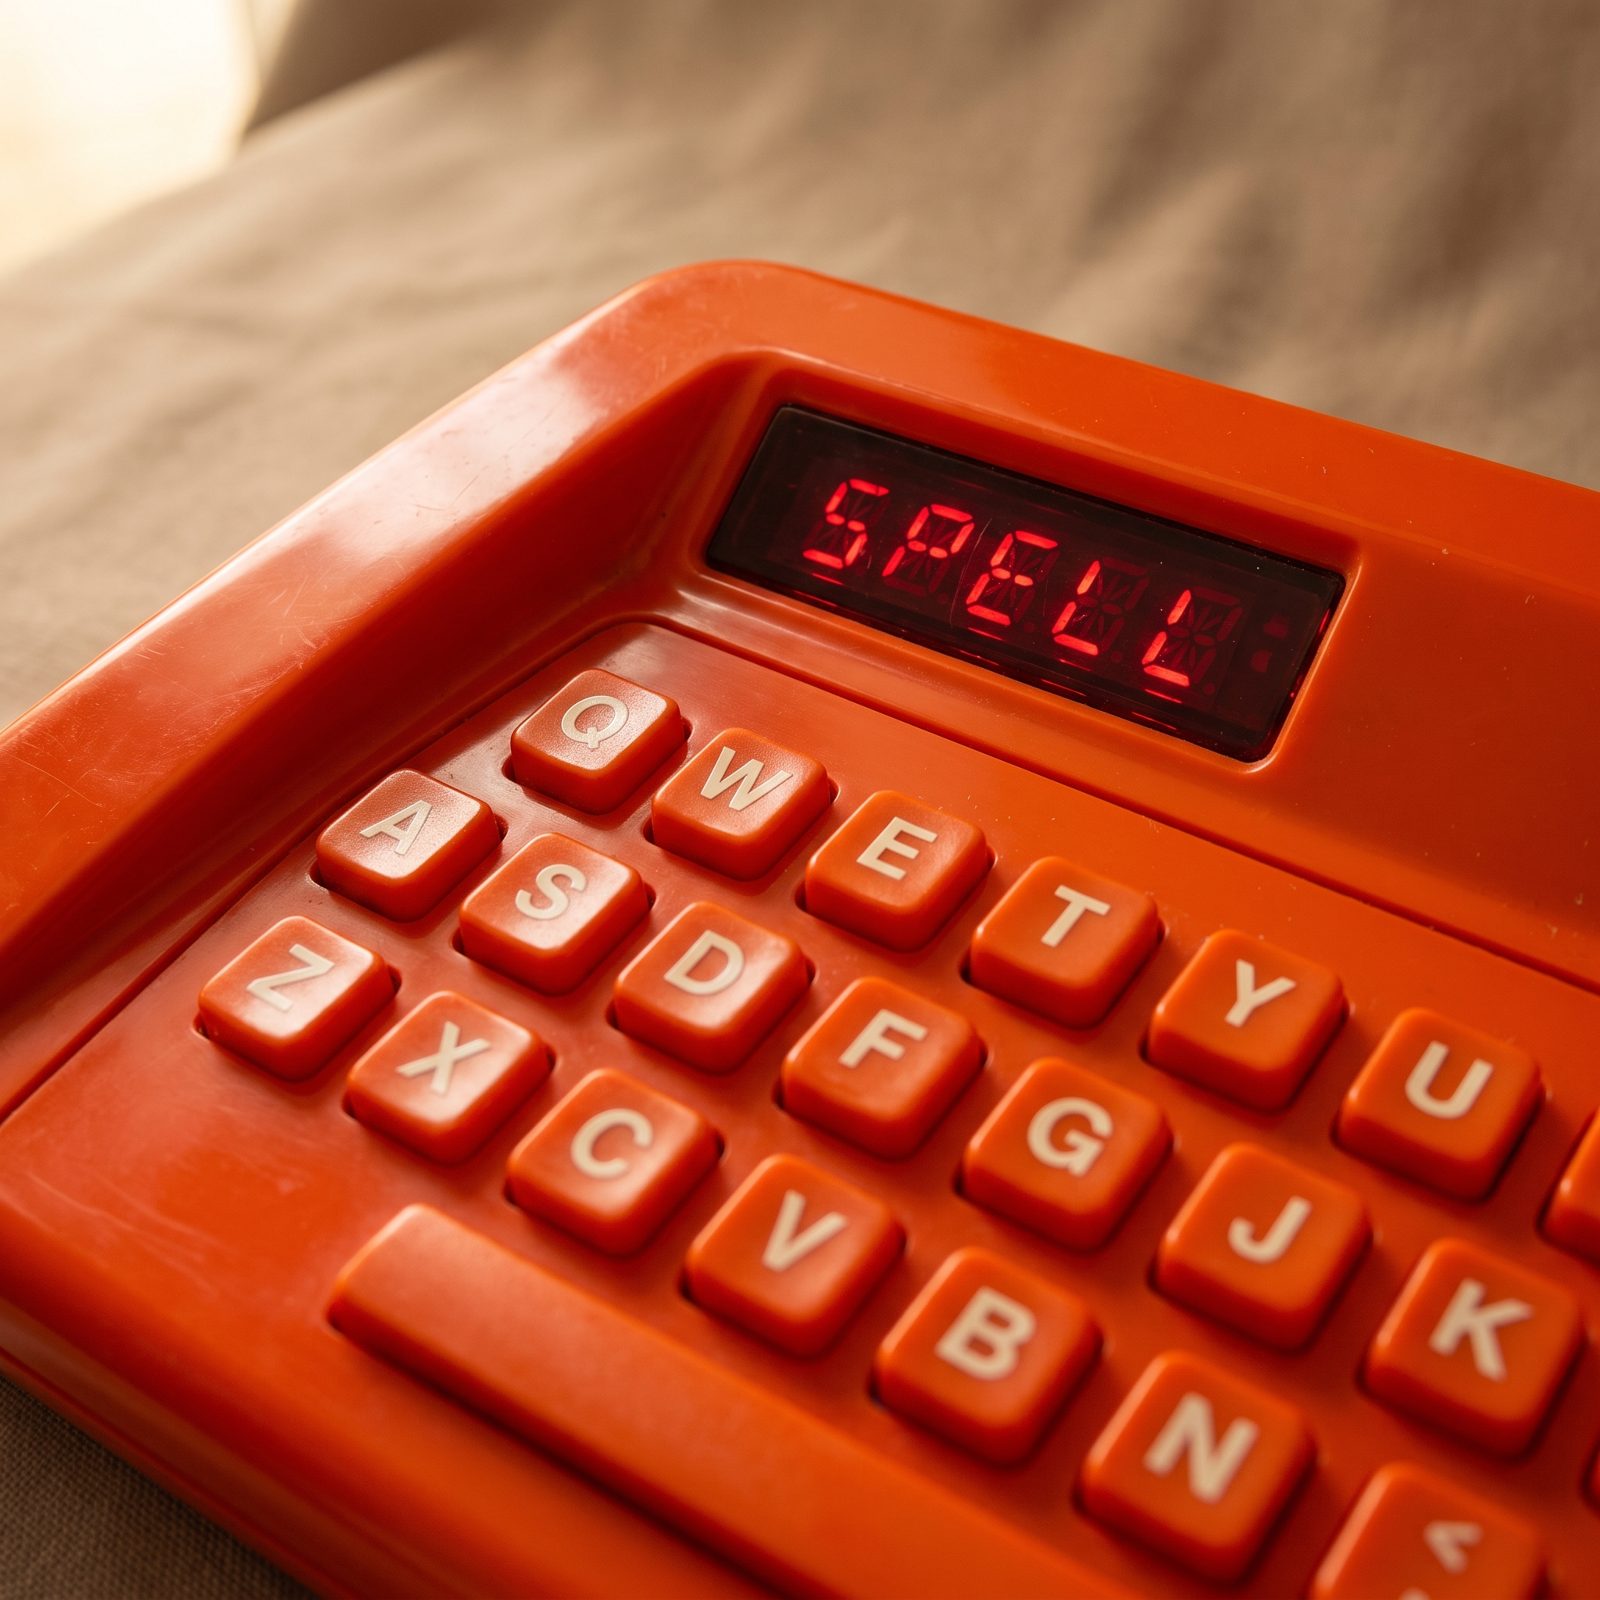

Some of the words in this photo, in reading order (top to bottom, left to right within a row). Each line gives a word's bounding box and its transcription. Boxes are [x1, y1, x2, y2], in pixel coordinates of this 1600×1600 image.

[804, 479, 1192, 687] SPELL
[359, 799, 433, 855] A
[515, 864, 587, 920] S
[664, 930, 745, 995] D
[840, 1010, 927, 1070] F
[1028, 1099, 1112, 1174] G
[1229, 1196, 1312, 1263] J
[1429, 1279, 1532, 1381] K
[561, 695, 629, 748] Q
[700, 746, 793, 811] W
[856, 816, 937, 880] E
[1041, 885, 1111, 947] T
[1226, 960, 1296, 1027] Y
[1406, 1042, 1493, 1118] U
[245, 943, 336, 1013] Z
[396, 1021, 491, 1094] X
[571, 1108, 653, 1179] C
[764, 1190, 847, 1272] V
[936, 1288, 1034, 1379] B
[1144, 1394, 1258, 1500] N
